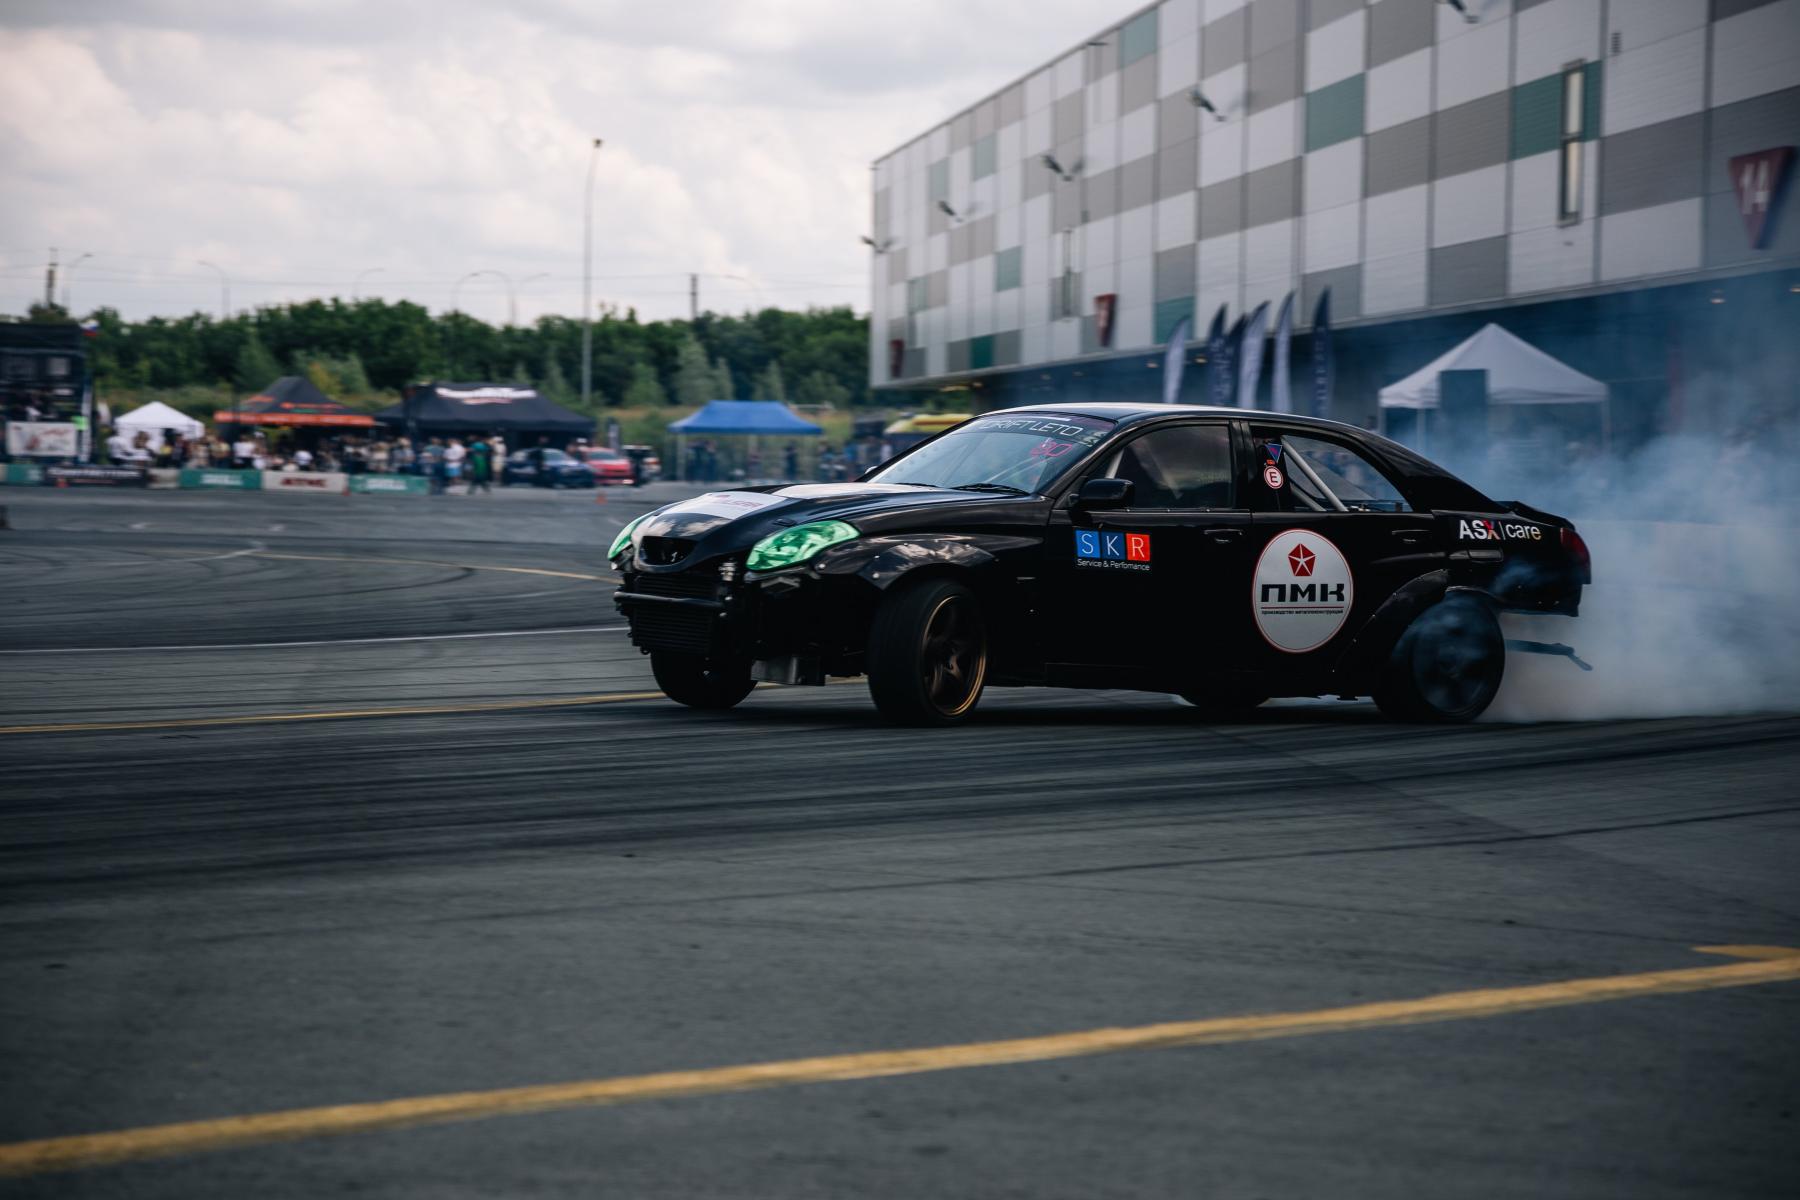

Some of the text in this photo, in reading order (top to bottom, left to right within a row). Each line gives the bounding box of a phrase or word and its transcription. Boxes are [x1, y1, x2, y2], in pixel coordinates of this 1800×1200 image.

[1740, 160, 1769, 215] 14
[1029, 421, 1084, 437] LETO
[1269, 471, 1279, 483] E
[1460, 519, 1542, 540] ASX care
[1077, 558, 1102, 567] Service
[1103, 560, 1109, 568] &
[1261, 584, 1345, 602] ПМК
